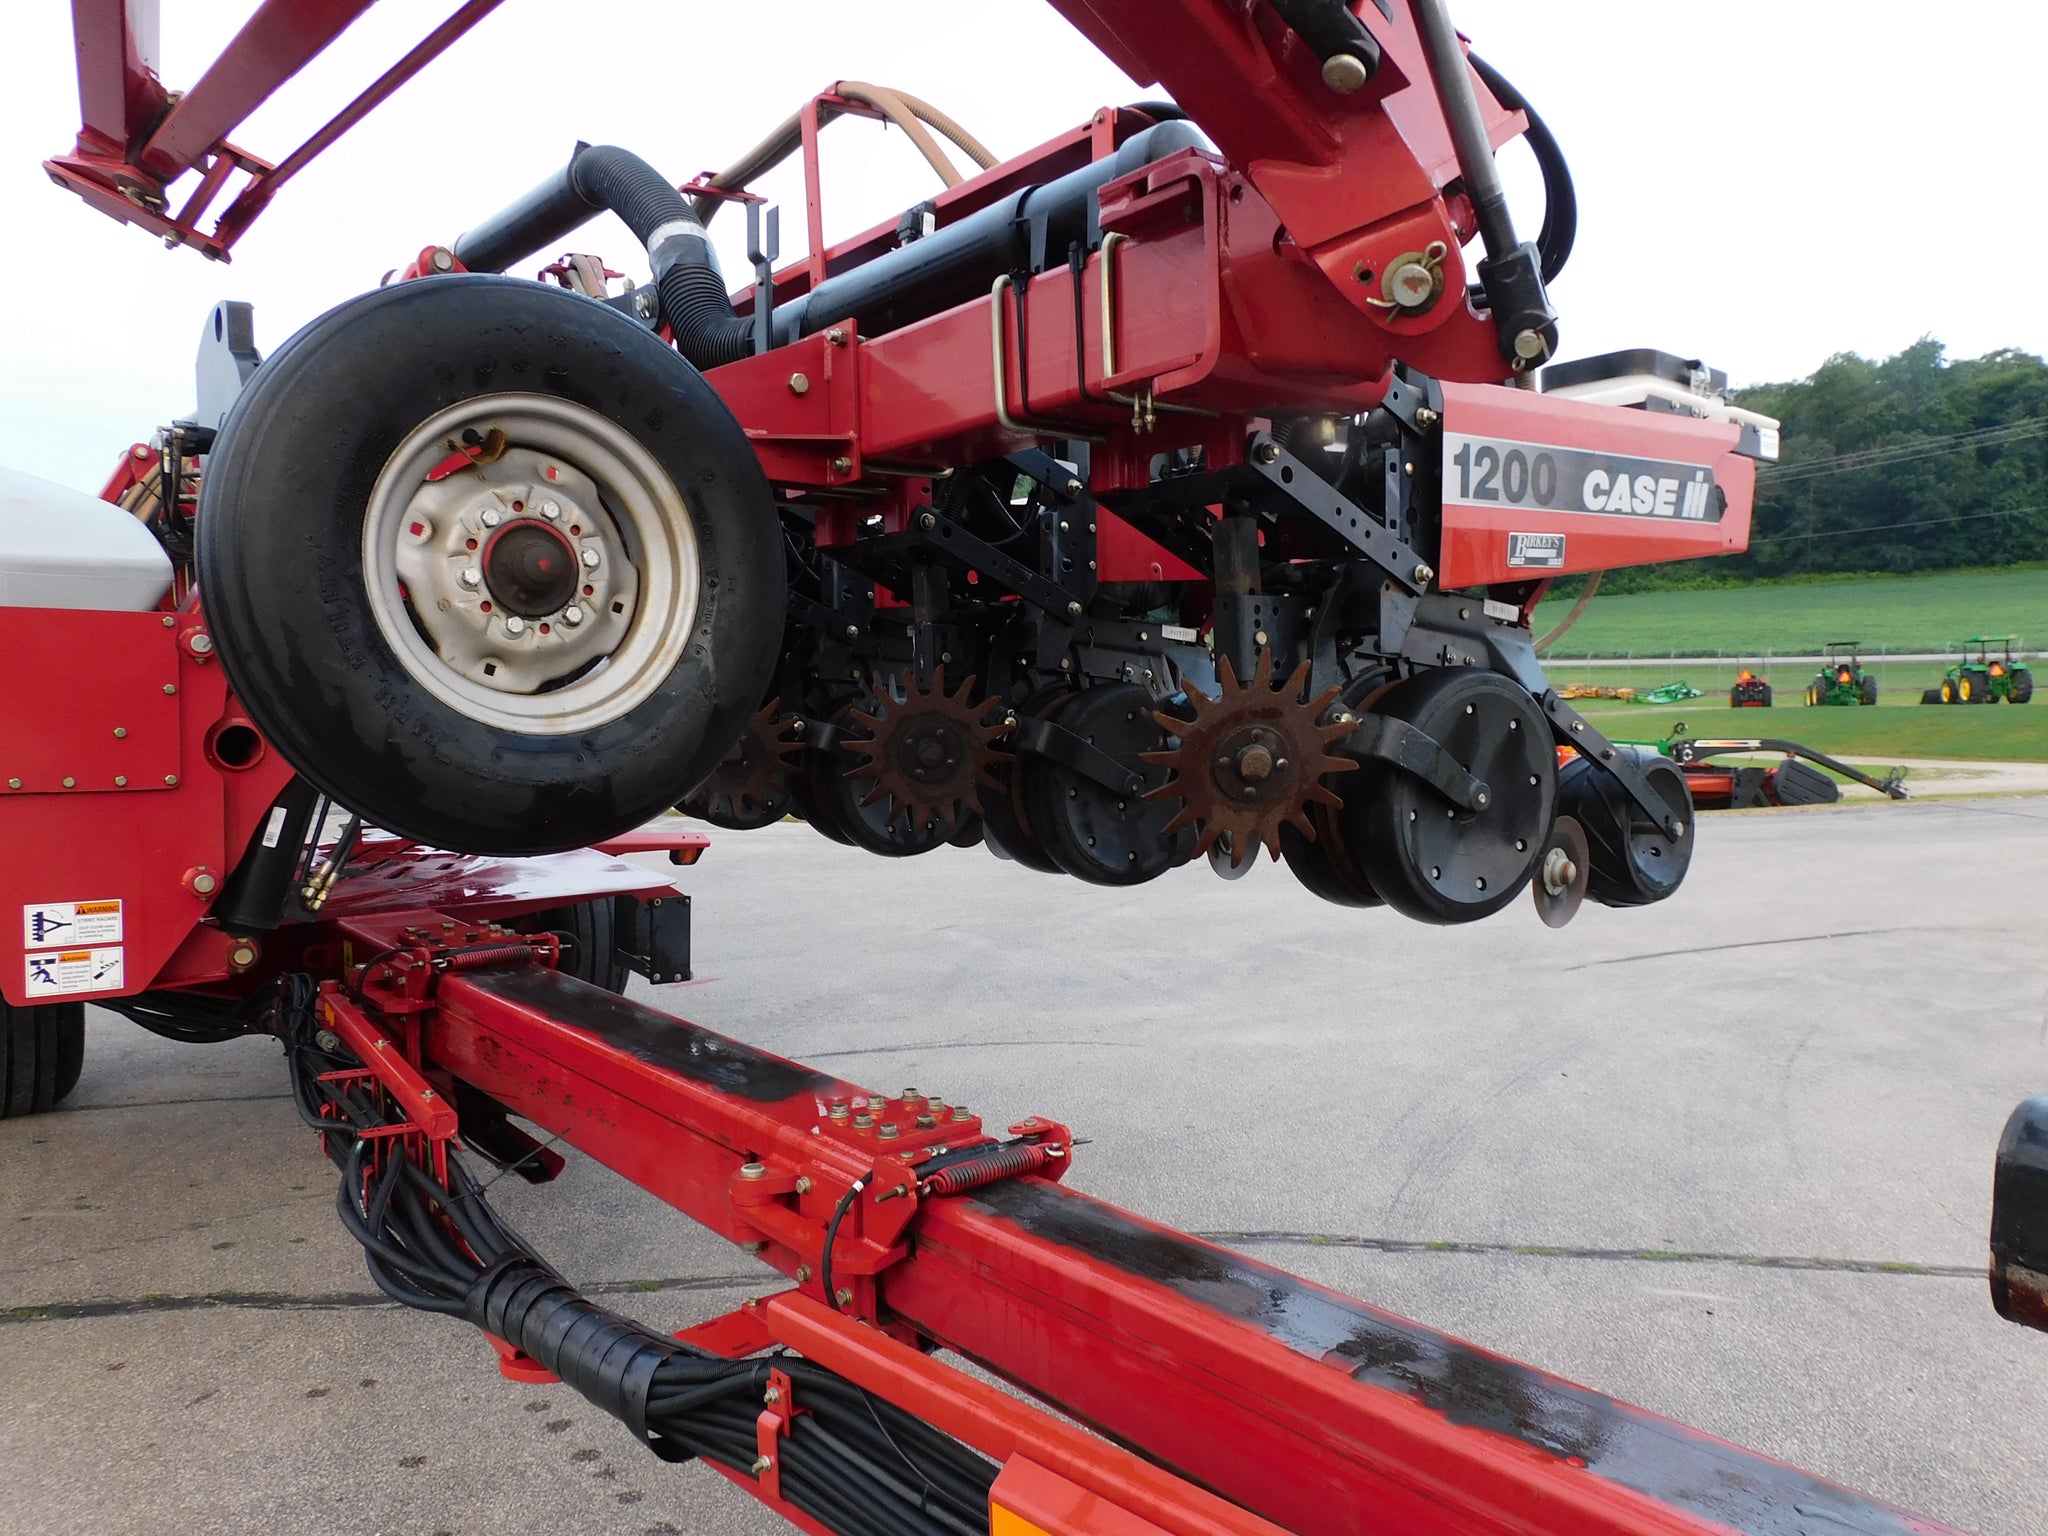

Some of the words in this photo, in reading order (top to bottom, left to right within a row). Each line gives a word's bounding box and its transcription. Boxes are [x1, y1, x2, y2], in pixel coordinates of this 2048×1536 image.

[1453, 443, 1556, 506] 1200
[1583, 469, 1679, 516] CASE
[86, 905, 119, 914] WARNING
